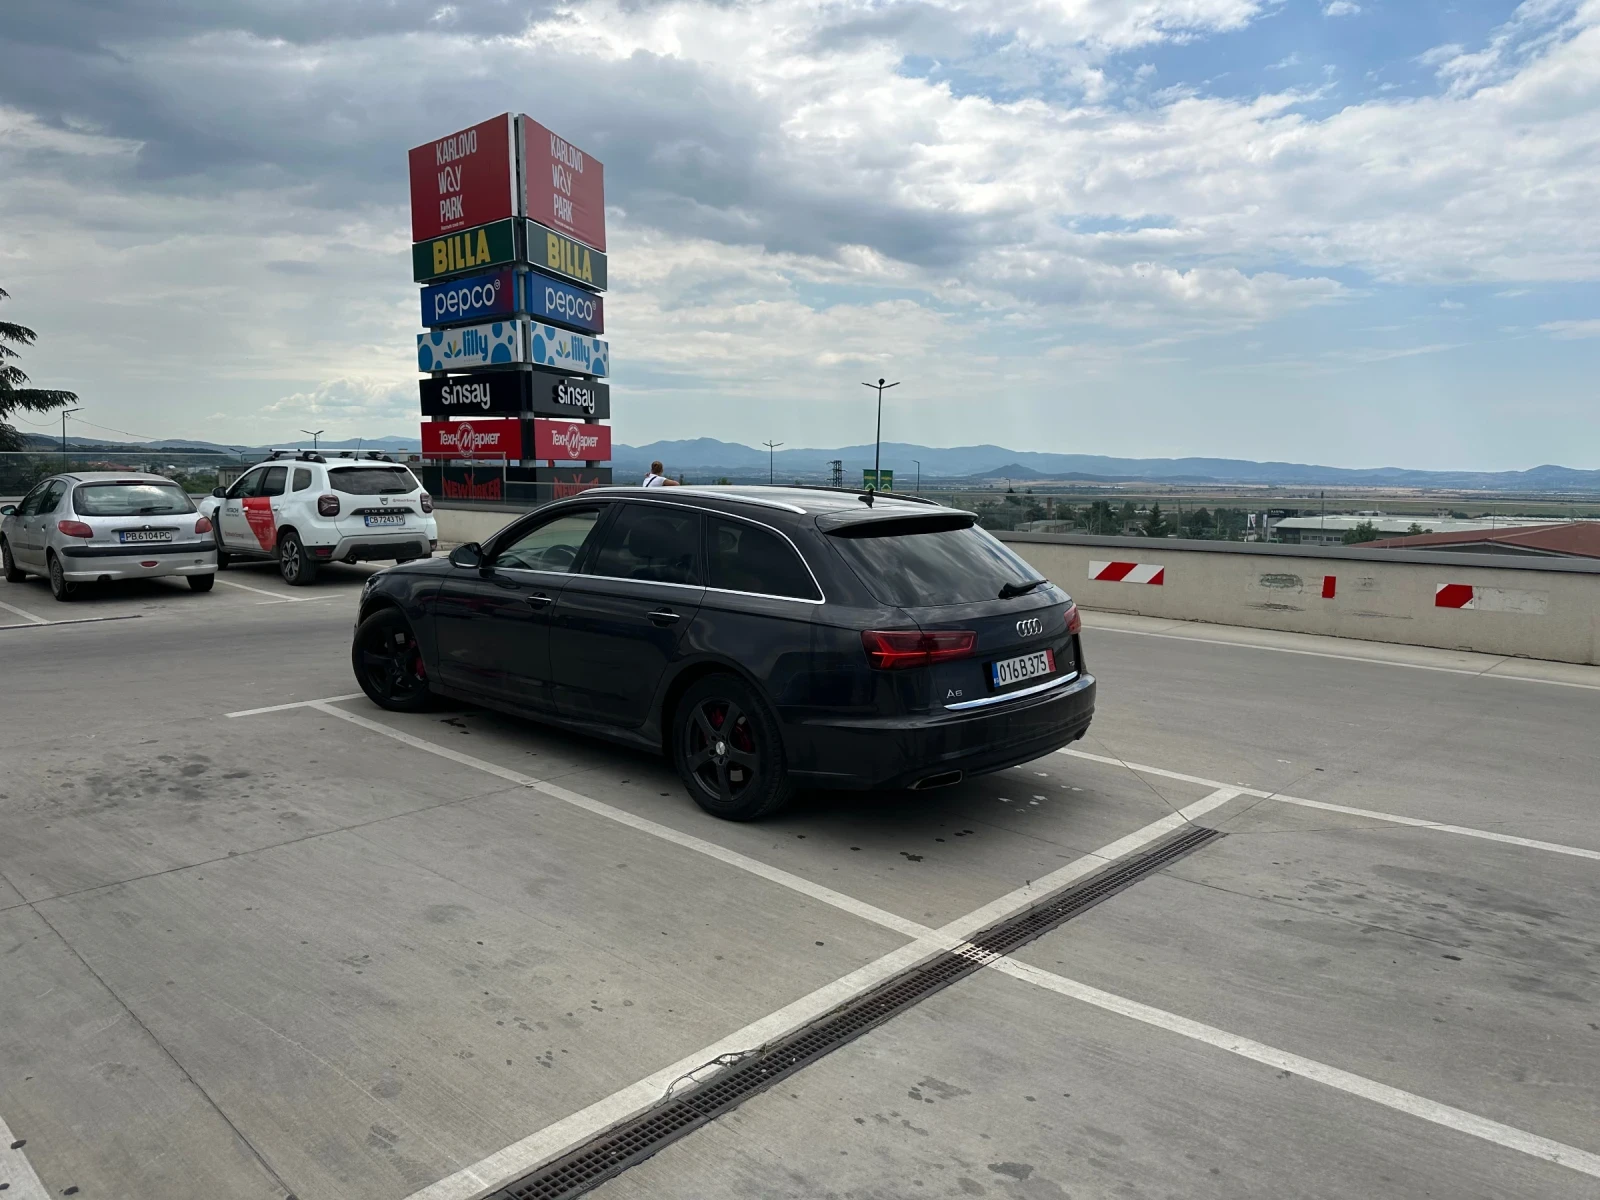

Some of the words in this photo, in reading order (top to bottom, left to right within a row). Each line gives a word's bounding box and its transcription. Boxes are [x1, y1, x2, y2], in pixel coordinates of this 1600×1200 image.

[436, 129, 477, 166] KARLOVO
[550, 133, 584, 174] KARLOVO
[440, 194, 464, 223] PARK
[553, 193, 573, 224] PARK
[432, 229, 491, 275] BILLA
[547, 232, 593, 283] BILLA
[462, 329, 489, 361] lilly
[570, 335, 590, 370] lilly
[441, 379, 490, 410] sinsay
[557, 379, 595, 414] sinsay
[379, 515, 395, 523] 7243
[125, 532, 137, 541] PB
[138, 531, 158, 540] 6104
[159, 531, 171, 539] PC
[946, 689, 963, 699] A6
